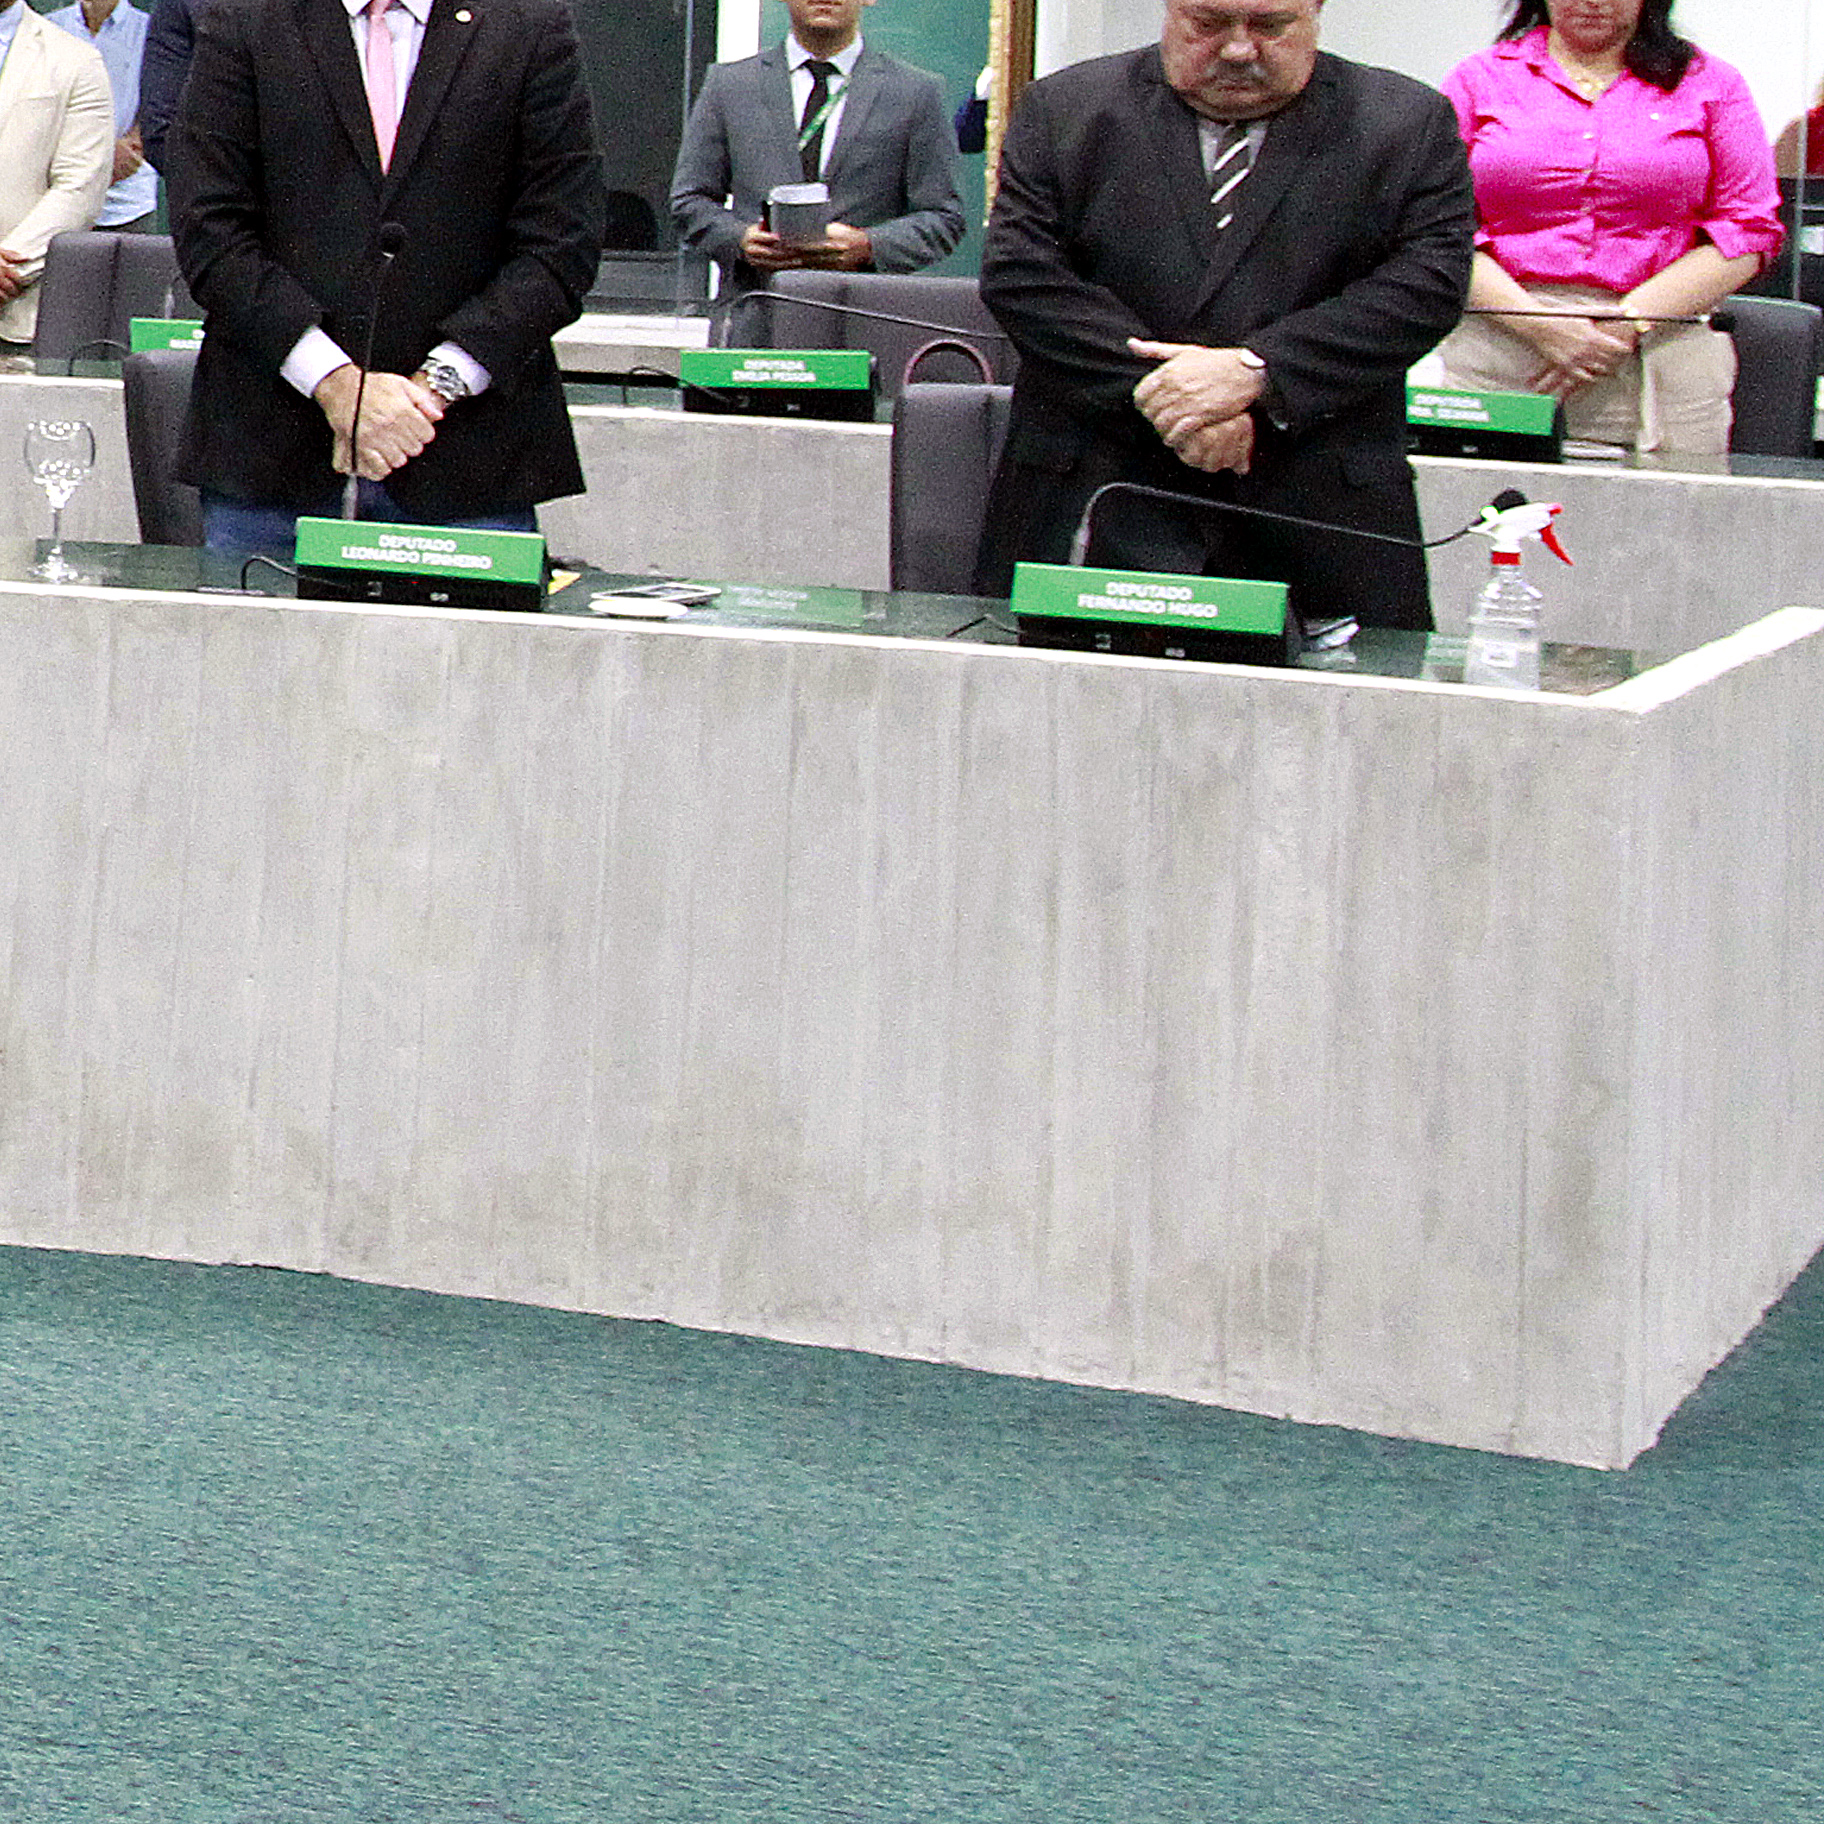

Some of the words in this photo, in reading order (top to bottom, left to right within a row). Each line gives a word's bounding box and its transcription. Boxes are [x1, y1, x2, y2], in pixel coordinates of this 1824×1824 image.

[378, 534, 457, 553] DEPUTADO
[341, 546, 421, 564] LEONARDO
[421, 551, 493, 570] PINHEIRO
[1106, 581, 1194, 601] DEPUTADO
[1077, 593, 1167, 615] FERNANDO
[1167, 602, 1219, 618] HUGO
